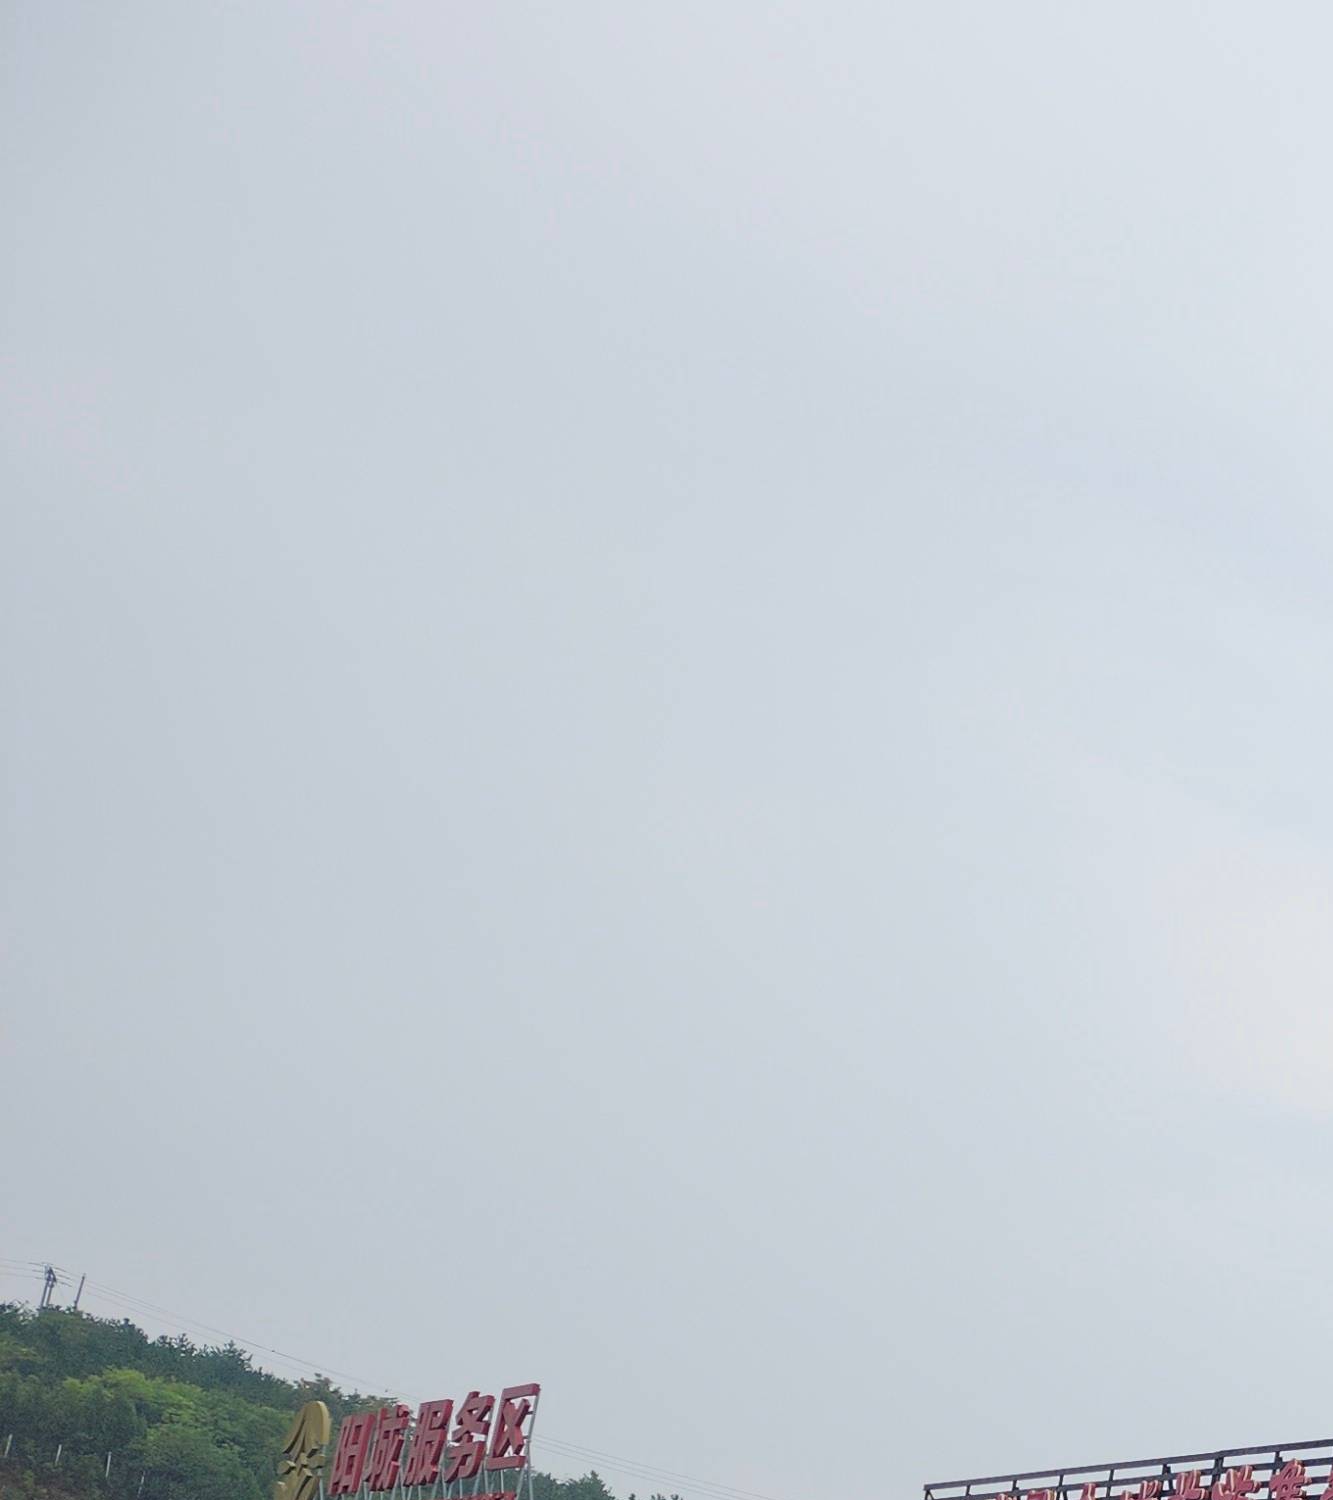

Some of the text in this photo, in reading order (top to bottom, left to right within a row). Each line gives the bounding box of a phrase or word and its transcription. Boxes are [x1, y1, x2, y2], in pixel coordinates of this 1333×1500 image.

[328, 1382, 541, 1497] 阳城服务区
